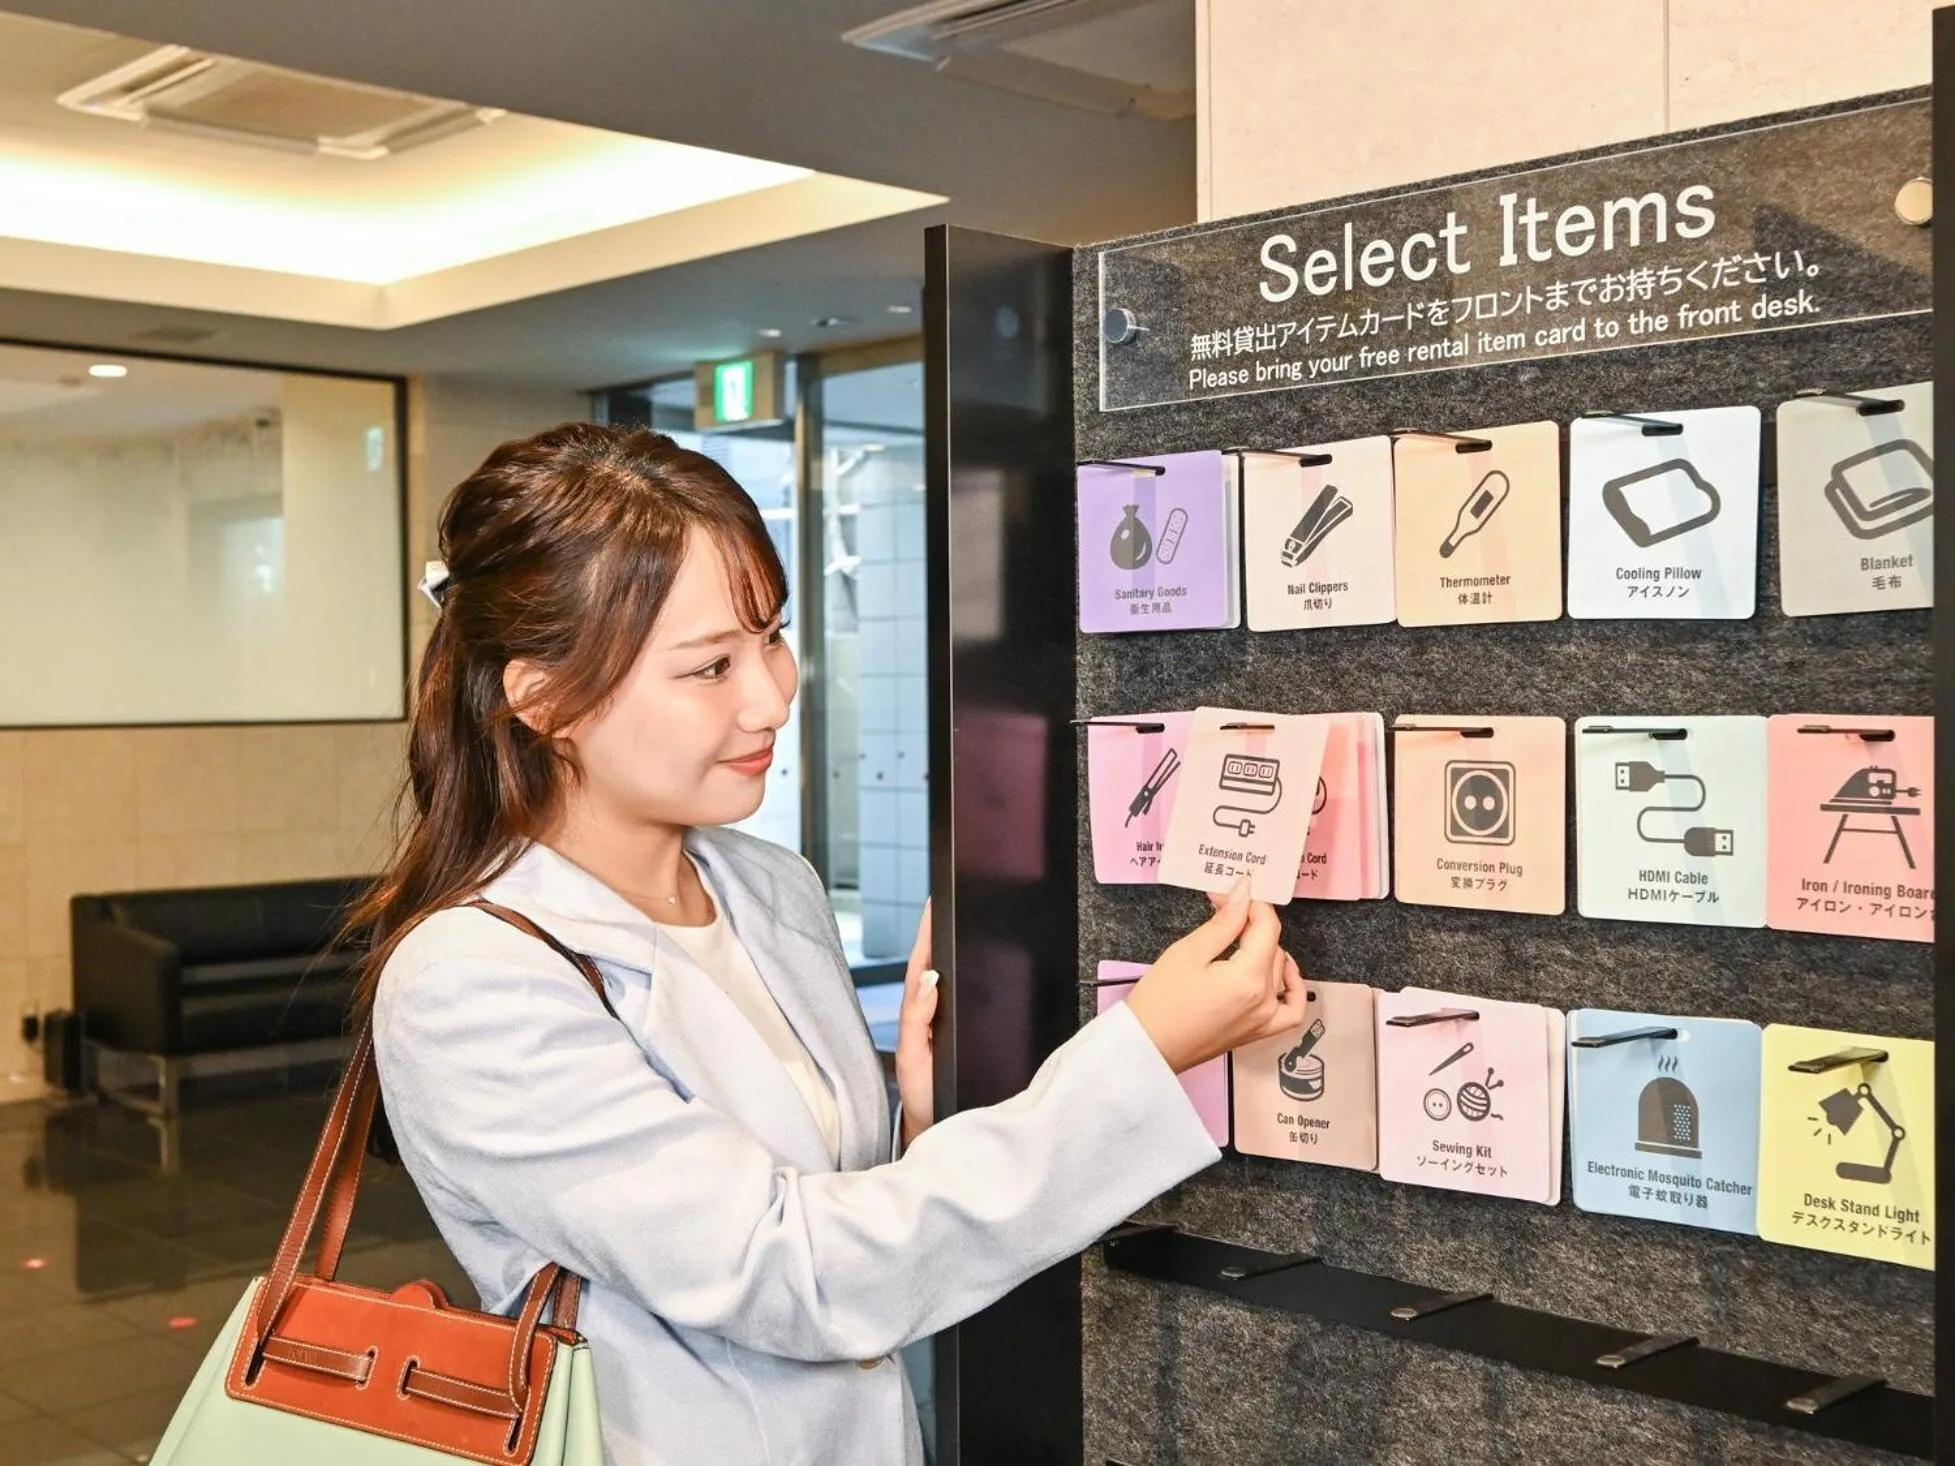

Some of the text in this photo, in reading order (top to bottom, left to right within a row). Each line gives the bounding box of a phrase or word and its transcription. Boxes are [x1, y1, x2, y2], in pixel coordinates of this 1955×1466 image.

[1259, 184, 1716, 303] Select Items
[1190, 249, 1820, 361] 無料貸出アイテムカードをフロントまでお持ちください。
[1189, 288, 1821, 390] Please bring your free rental item card to the front desk.
[1860, 553, 1913, 571] Blanket
[1439, 573, 1511, 589] Thermometer
[1615, 566, 1702, 581] Cooling Pillow
[1871, 574, 1902, 590] 毛布
[1114, 585, 1188, 601] Sanitary Goods
[1287, 581, 1349, 596] Nail Clippers
[1626, 584, 1691, 599] アイスノン
[1303, 597, 1333, 611] 爪切り
[1457, 591, 1493, 605] 体温計
[1135, 841, 1153, 851] Hair
[1198, 843, 1267, 865] Extension Cord
[1129, 855, 1161, 867] ヘアア
[1305, 852, 1327, 864] Cord
[1435, 857, 1524, 877] Conversion Plug
[1449, 875, 1509, 892] 変換プラグ
[1638, 869, 1709, 886] HDMI Cable
[1627, 887, 1721, 904] HDMIケーブル
[1801, 878, 1829, 893] Iron
[1832, 879, 1840, 893] /
[1843, 880, 1893, 900] Ironing
[1795, 896, 1935, 922] アイロン・アイロン
[1276, 1112, 1332, 1131] Can Opener
[1288, 1130, 1319, 1146] 缶切り
[1431, 1139, 1493, 1159] Sewing Kit
[1415, 1155, 1509, 1178] ソーイングセット
[1587, 1160, 1753, 1196] Electronic Mosquito Catcher
[1627, 1183, 1709, 1209] 電子蚊取り器
[1803, 1192, 1921, 1225] Desk Stand Light
[1790, 1210, 1932, 1246] デスクスタンドライト
